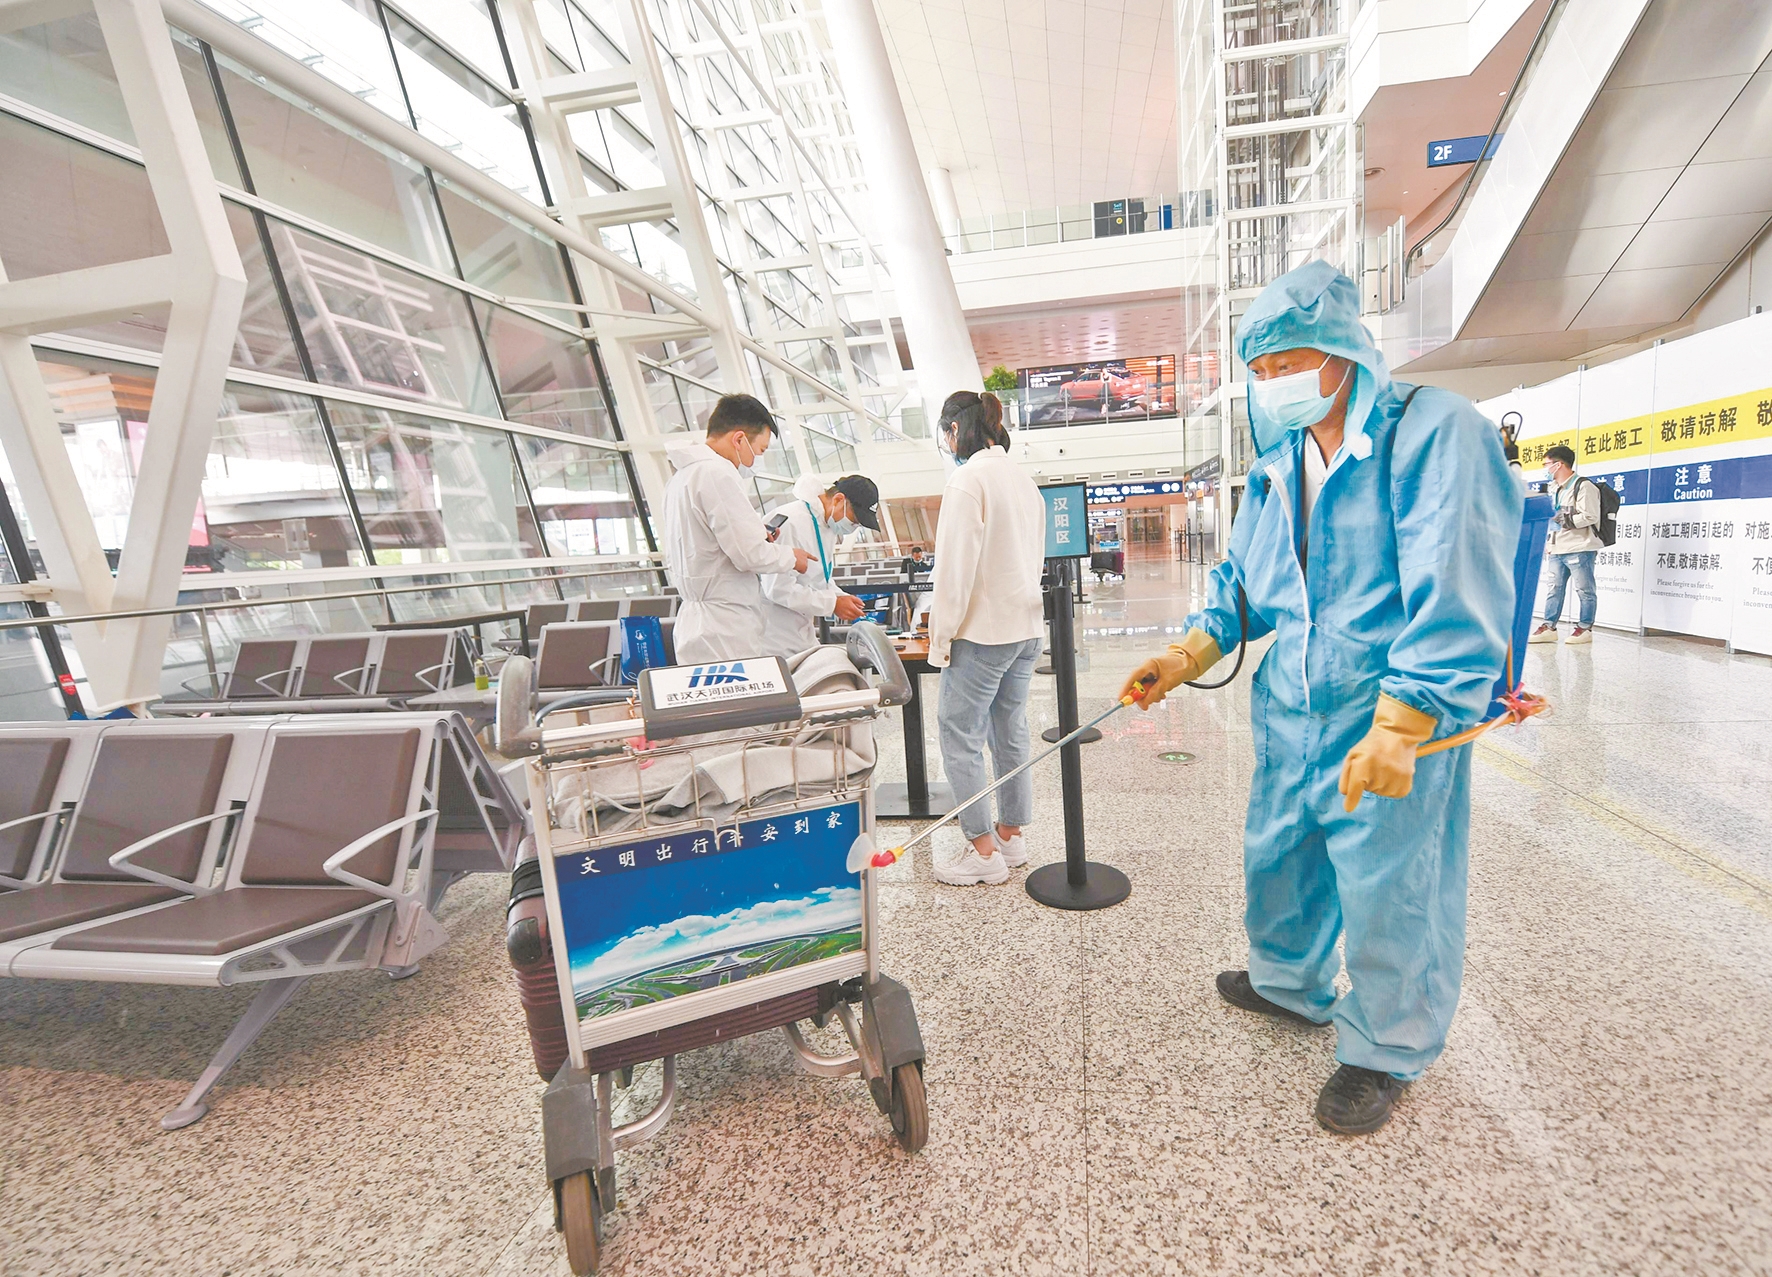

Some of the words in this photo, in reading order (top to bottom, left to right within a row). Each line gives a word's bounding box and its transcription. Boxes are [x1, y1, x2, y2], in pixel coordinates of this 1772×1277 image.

[1434, 145, 1453, 161] 2F
[1584, 427, 1643, 456] 在此施工
[1661, 407, 1738, 442] 敬请谅解
[1675, 464, 1712, 486] 注意
[1674, 487, 1713, 500] Caution
[1053, 497, 1071, 544] 汉阳区
[1651, 520, 1734, 539] 对施工期间引起的
[1657, 579, 1672, 587] Please
[1673, 579, 1690, 589] forgive
[1697, 581, 1705, 589] for
[1705, 581, 1714, 590] the
[1650, 589, 1684, 598] inconvenience
[1684, 591, 1705, 601] brought
[666, 681, 775, 702] 武汉天河国际机场
